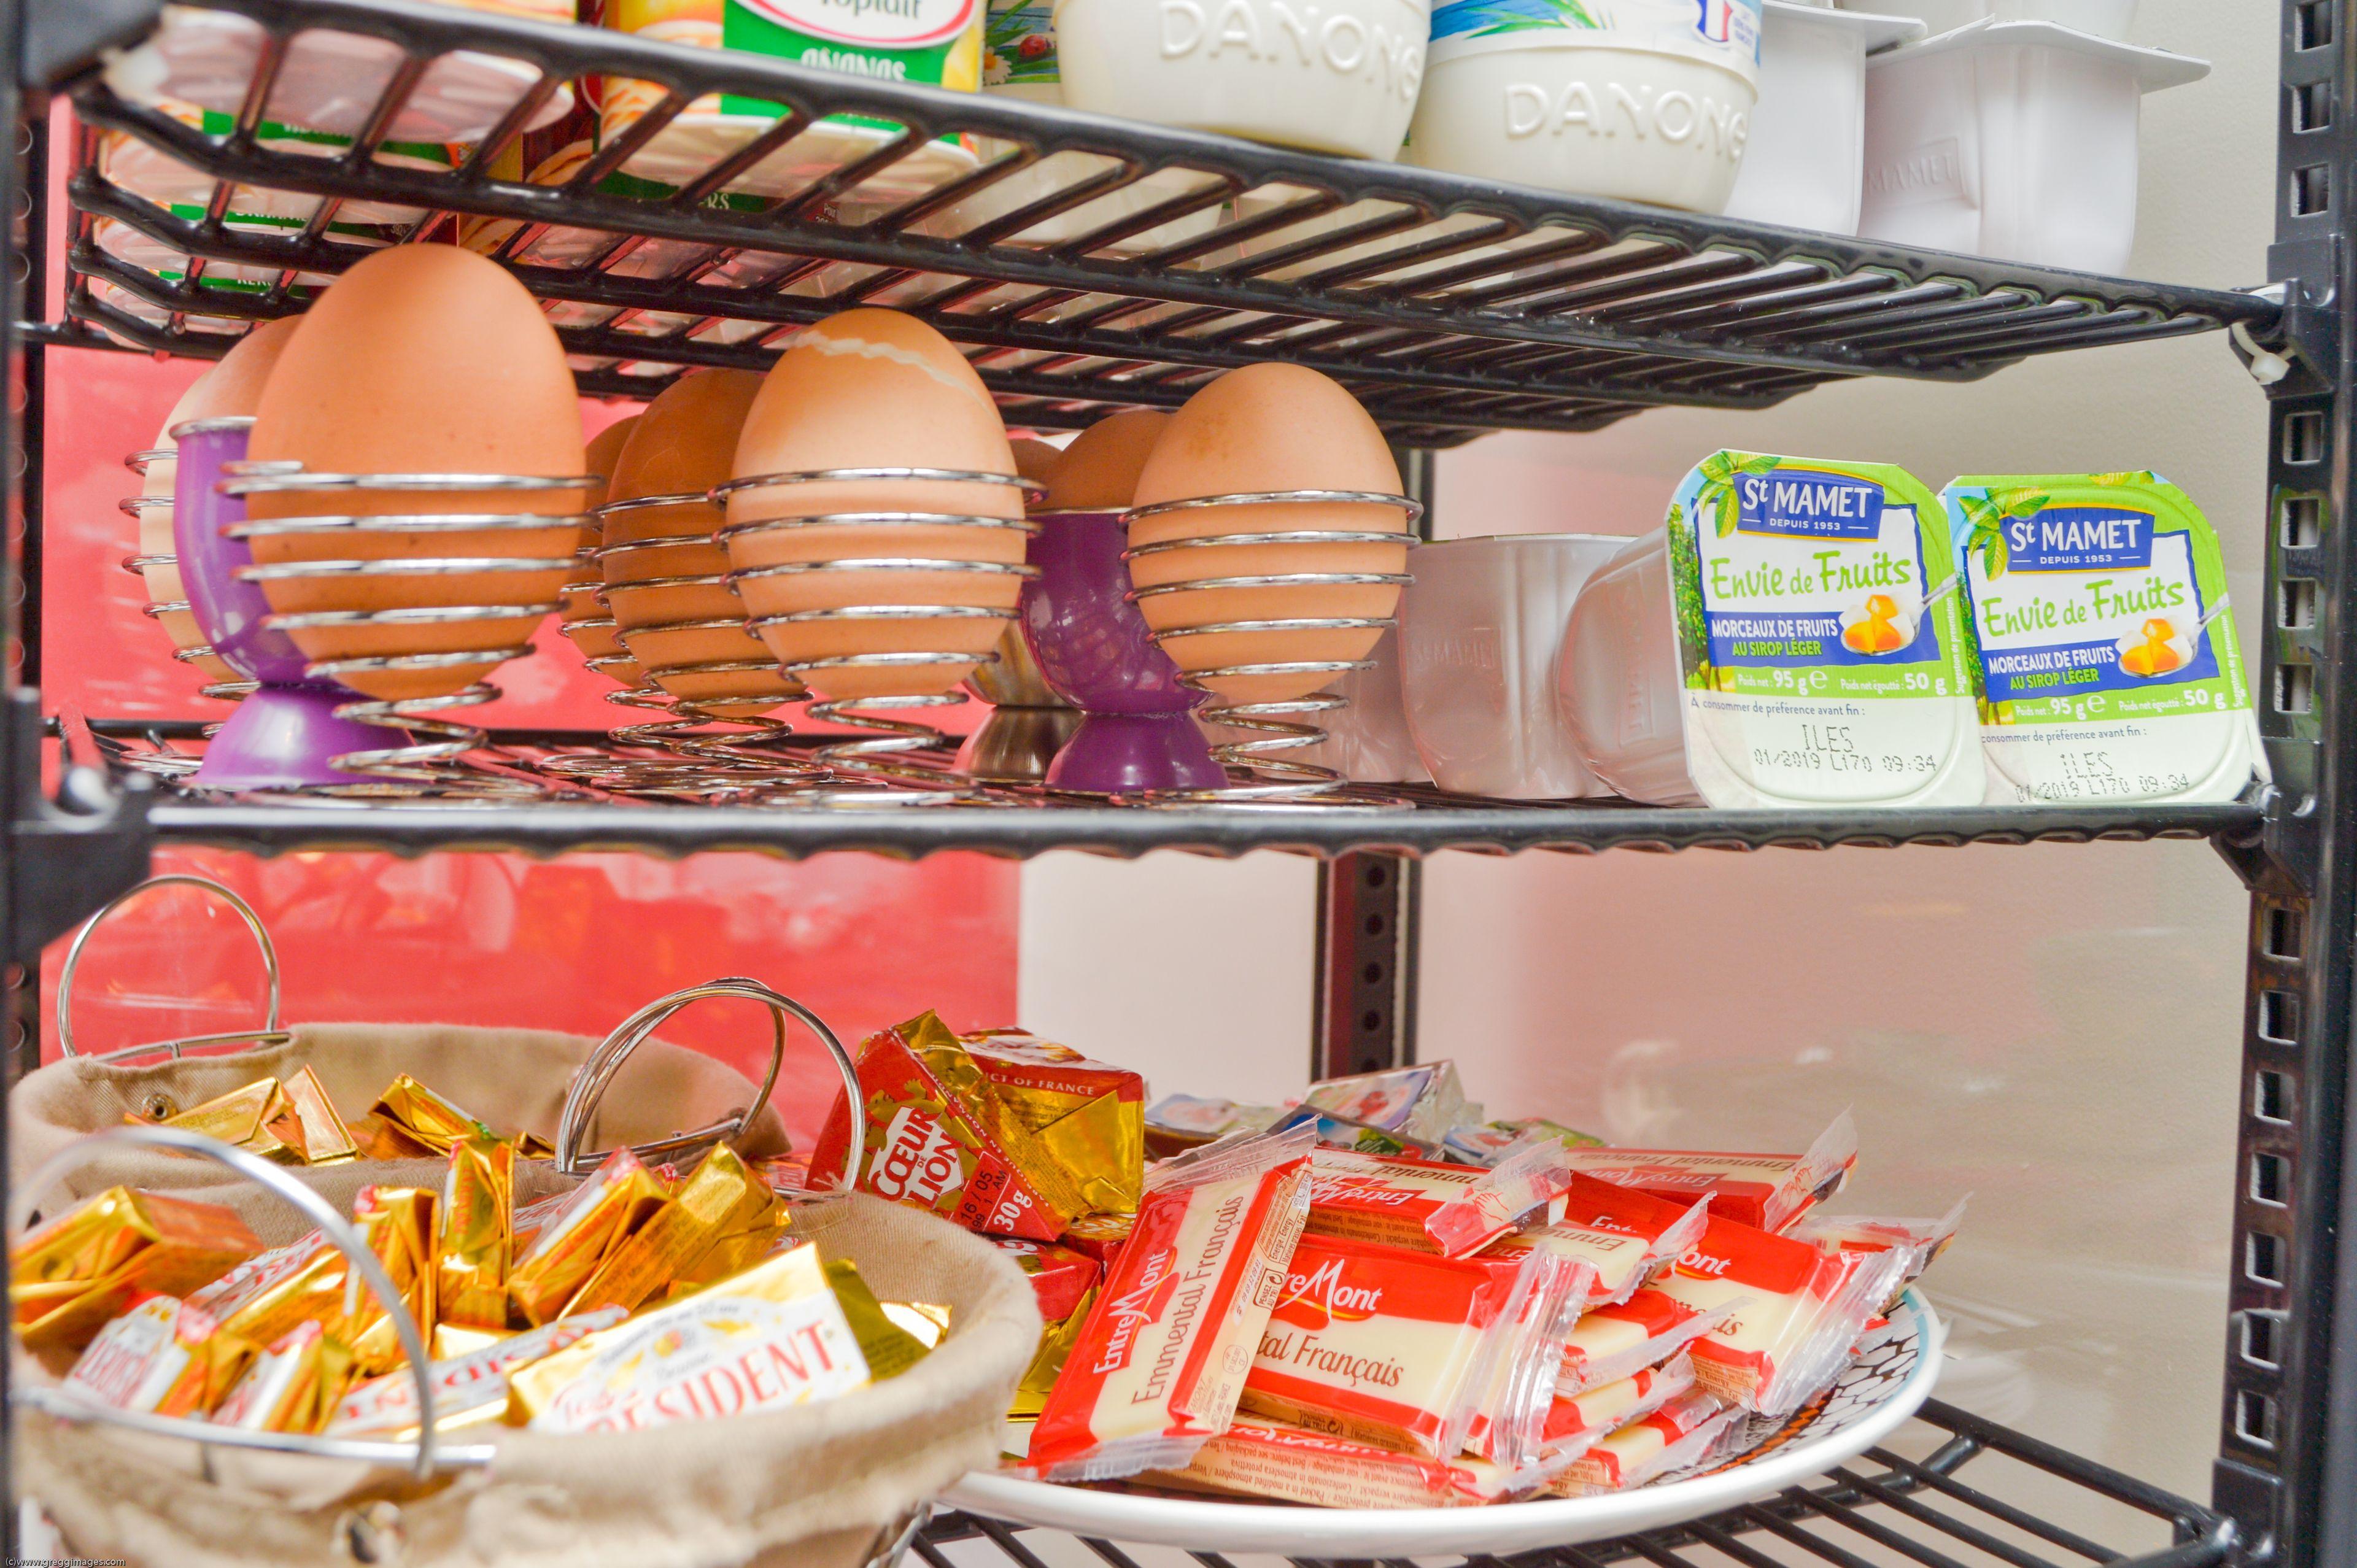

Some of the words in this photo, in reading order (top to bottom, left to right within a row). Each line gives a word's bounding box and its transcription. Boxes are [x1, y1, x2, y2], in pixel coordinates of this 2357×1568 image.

[821, 0, 922, 19] oplait
[1742, 478, 1769, 511] St
[1773, 482, 1873, 518] MAMET
[1770, 518, 1809, 529] DEPUIS
[2011, 522, 2036, 552] St
[2042, 519, 2141, 551] MAMET
[1709, 557, 1785, 599] Envie
[1790, 567, 1813, 594] de
[1813, 550, 1911, 592] Fruits
[1981, 597, 2057, 637] Envie
[2062, 599, 2087, 626] de
[2084, 576, 2185, 620] Fruits
[1711, 619, 1776, 638] MORCEAUX
[1778, 620, 1794, 638] DE
[1796, 619, 1839, 638] FRUITS
[1732, 642, 1748, 656] AU
[1750, 641, 1782, 656] SIROP
[1786, 638, 1822, 656] LÉGER
[1988, 652, 2053, 675] MORCEAUX
[2056, 651, 2072, 668] DE
[2072, 646, 2116, 666] FRUITS
[1738, 674, 1756, 685] Poids
[1773, 670, 1794, 688] 95
[1798, 678, 1808, 696] g
[1840, 678, 1859, 690] Poids
[1861, 681, 1872, 690] net
[1905, 673, 1929, 690] 50
[1935, 678, 1947, 696] g
[2010, 676, 2025, 690] AU
[2027, 674, 2060, 688] SIROP
[2062, 667, 2100, 686] LÉGER
[1703, 700, 1750, 712] consommer
[1753, 701, 1763, 713] de
[1767, 702, 1815, 717] préférence
[1818, 706, 1843, 716] avant
[1846, 704, 1859, 716] fin
[2015, 705, 2034, 716] Poids
[2050, 698, 2072, 715] 95
[2076, 703, 2086, 720] g
[2119, 700, 2138, 711] Poids
[2183, 689, 2208, 706] 50
[2215, 693, 2226, 709] g
[1982, 731, 2030, 743] consommer
[2034, 730, 2044, 741] de
[2047, 729, 2096, 745] préférence
[2099, 728, 2125, 739] avant
[2127, 725, 2141, 736] fin
[1014, 1078, 1034, 1086] OF
[1039, 1080, 1096, 1095] FRANCE
[908, 1132, 964, 1208] LION
[917, 1156, 927, 1168] DE
[961, 1202, 977, 1220] 16
[976, 1171, 993, 1190] 05
[1279, 1216, 1295, 1237] Energy
[1131, 1284, 1206, 1405] Emmental
[1183, 1195, 1244, 1286] Français
[1258, 1284, 1272, 1305] PENSEZ
[1266, 1297, 1275, 1307] AU
[1093, 1248, 1168, 1374] EntreMont
[1290, 1334, 1404, 1389] Français
[1225, 1439, 1258, 1456] packaging
[1263, 1464, 1298, 1480] atmosfera
[1291, 1456, 1306, 1468] Best
[1213, 1466, 1253, 1485] atmosphere
[1253, 1476, 1283, 1492] modified
[1306, 1473, 1352, 1493] Confezionato
[1300, 1485, 1325, 1500] Packed
